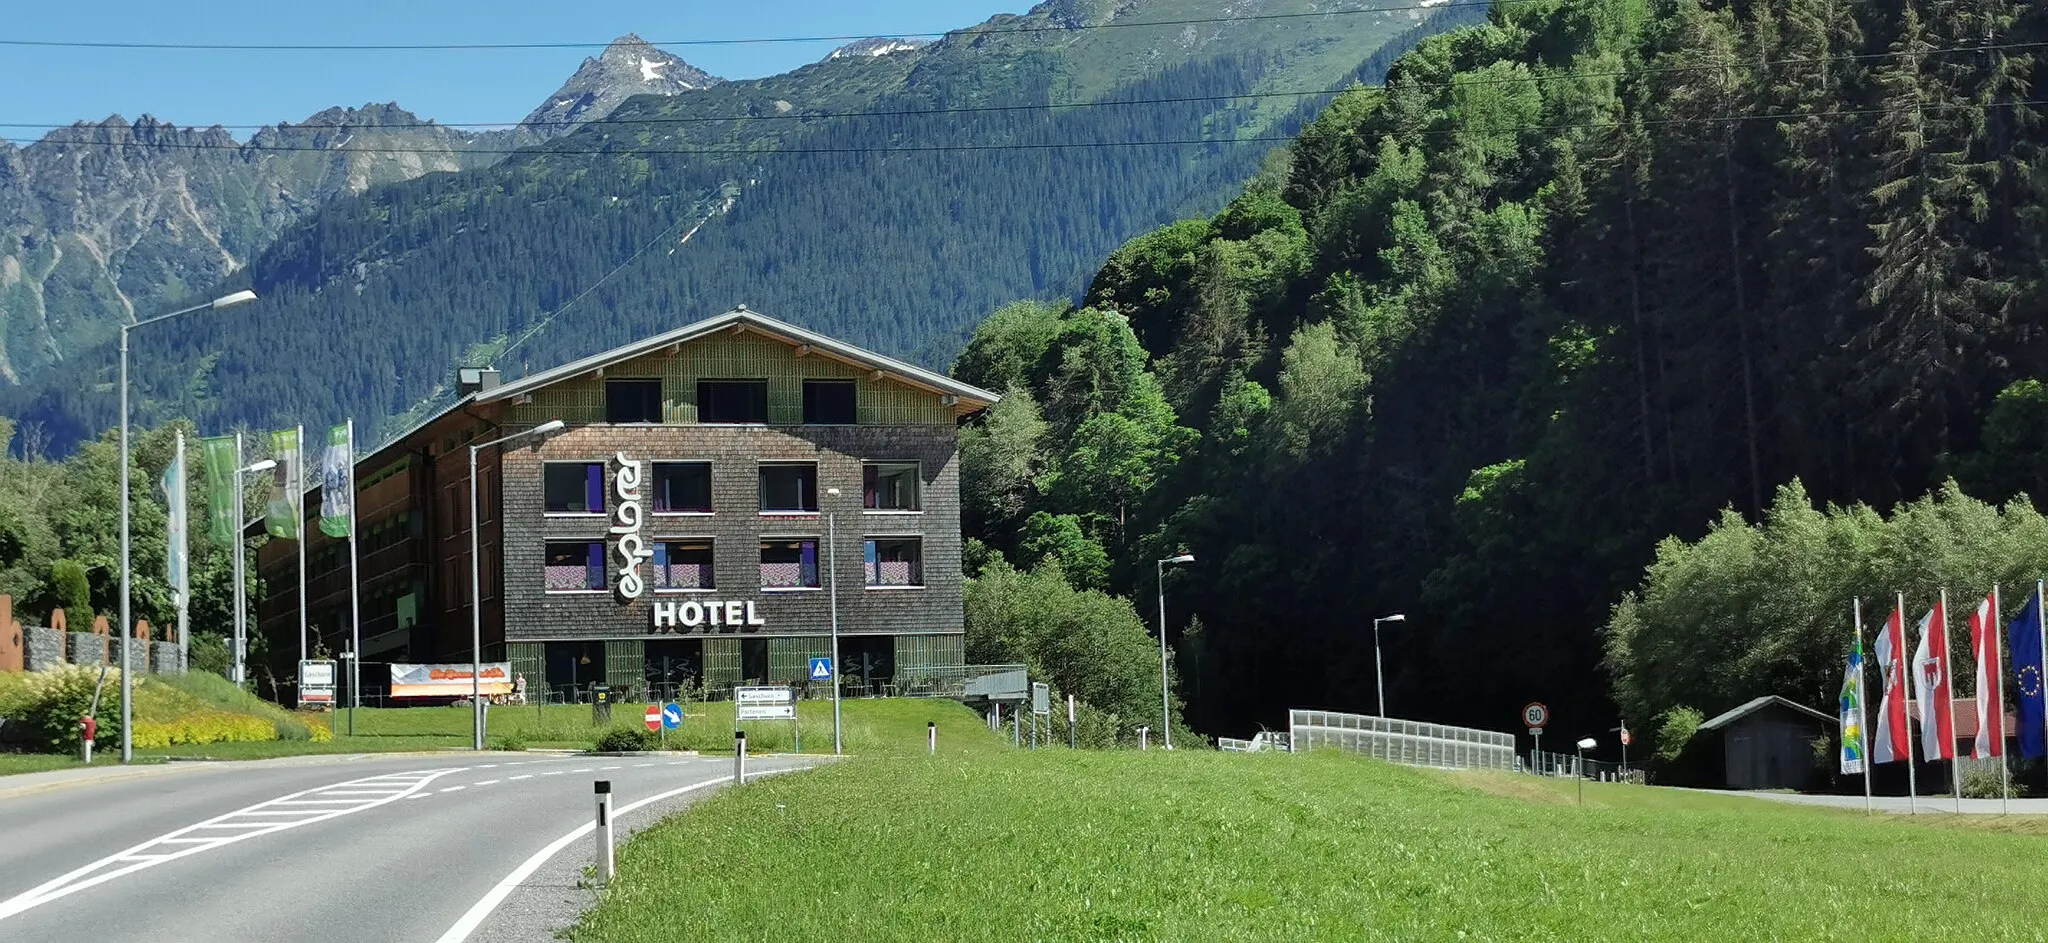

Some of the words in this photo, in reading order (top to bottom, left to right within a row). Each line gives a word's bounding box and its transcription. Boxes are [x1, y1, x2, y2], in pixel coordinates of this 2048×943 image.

[609, 451, 654, 598] explorer
[653, 600, 765, 627] HOTEL
[1529, 709, 1541, 721] 60
